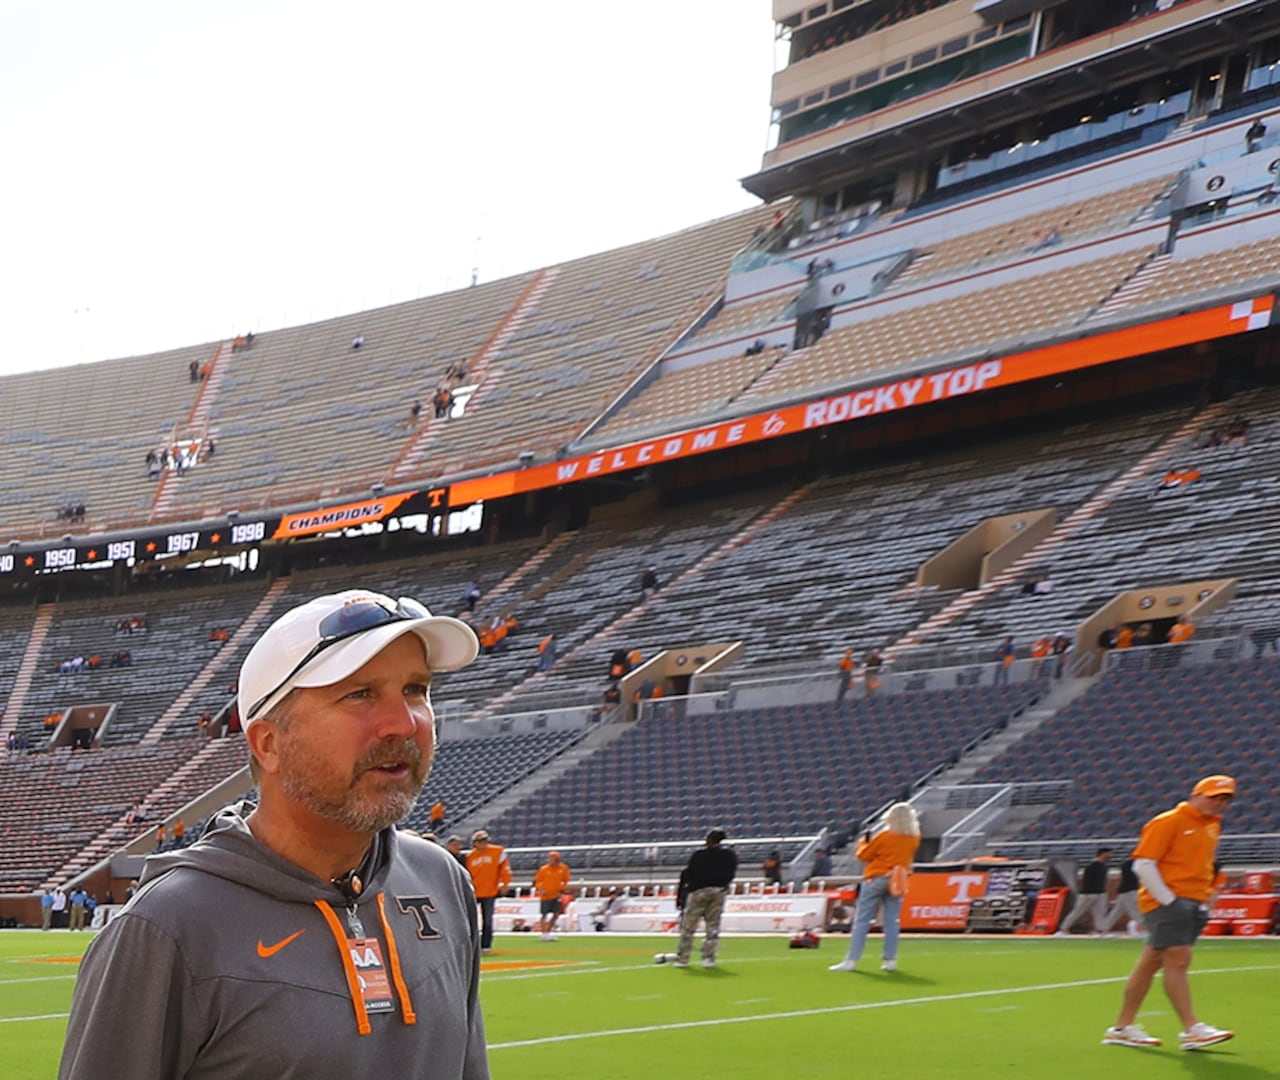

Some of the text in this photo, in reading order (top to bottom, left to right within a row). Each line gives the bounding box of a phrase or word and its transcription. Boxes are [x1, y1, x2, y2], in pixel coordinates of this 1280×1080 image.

[555, 360, 1002, 481] WELCOME to ROCKY TOP
[288, 503, 385, 531] CHAMPIONS
[44, 548, 76, 567] 1950
[107, 541, 136, 560] 1951
[167, 532, 201, 551] 1967
[230, 522, 266, 544] 1998
[947, 875, 983, 903] T
[394, 894, 443, 940] T
